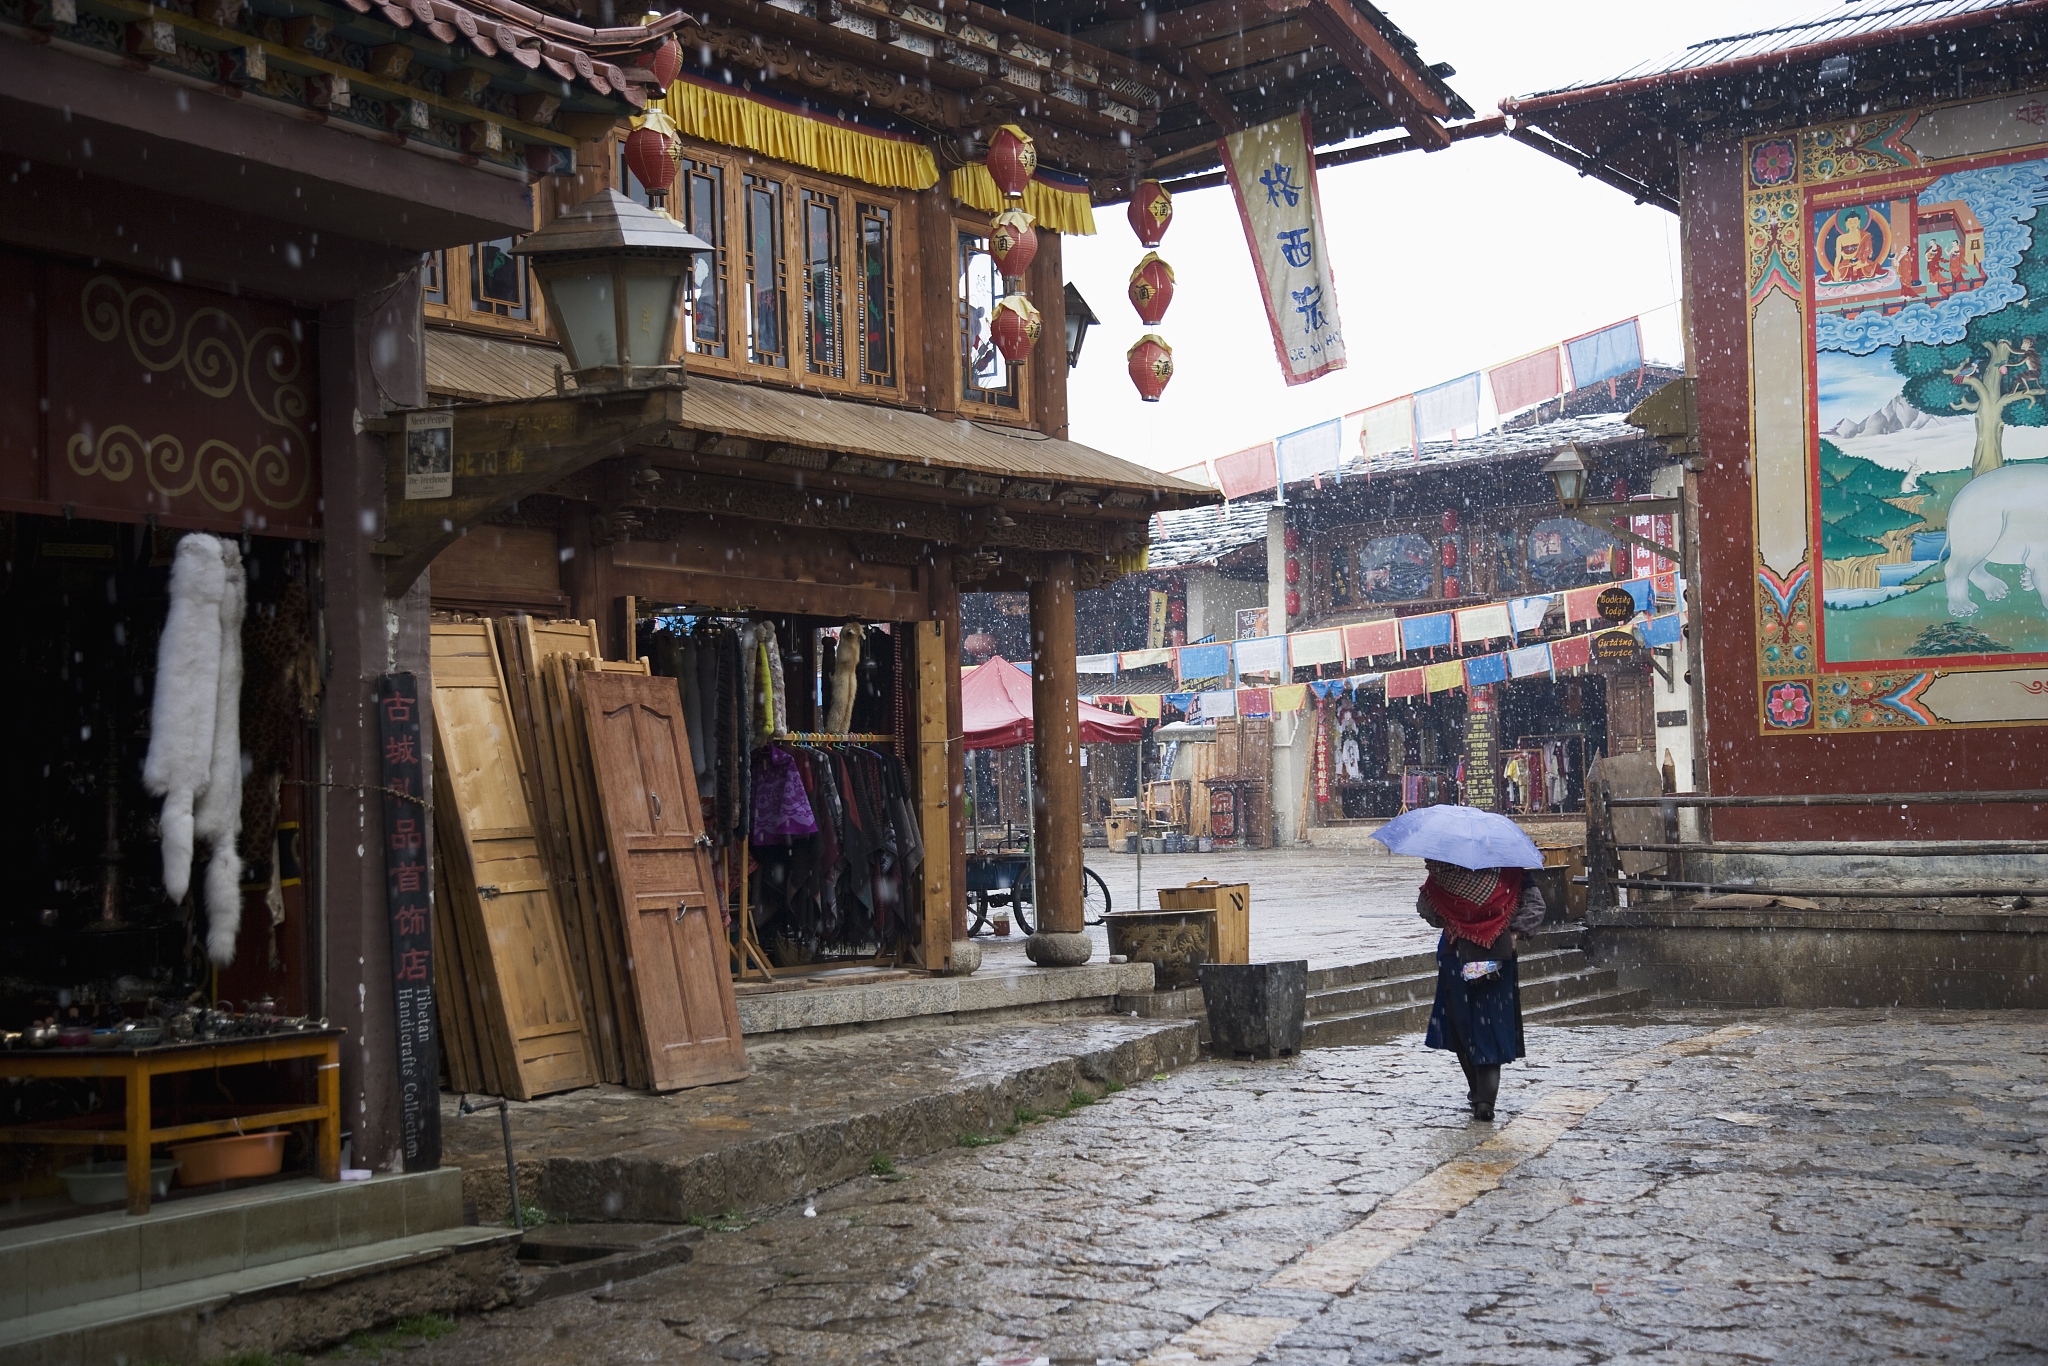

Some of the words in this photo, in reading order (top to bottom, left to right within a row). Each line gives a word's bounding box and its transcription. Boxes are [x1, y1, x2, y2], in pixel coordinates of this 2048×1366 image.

[1153, 200, 1169, 217] 酒
[992, 234, 1009, 252] 酒
[1134, 284, 1150, 301] 酒
[1155, 359, 1170, 376] 酒
[411, 416, 427, 426] Meet
[427, 415, 449, 425] People
[408, 476, 419, 485] The
[420, 475, 450, 485] Treehouse
[1600, 594, 1631, 606] Booking
[1597, 637, 1633, 649] Guiding
[1598, 648, 1633, 658] service
[382, 690, 430, 982] 古城礼品首饰店
[416, 985, 431, 1043] Tibetan
[403, 1082, 421, 1159] Collection
